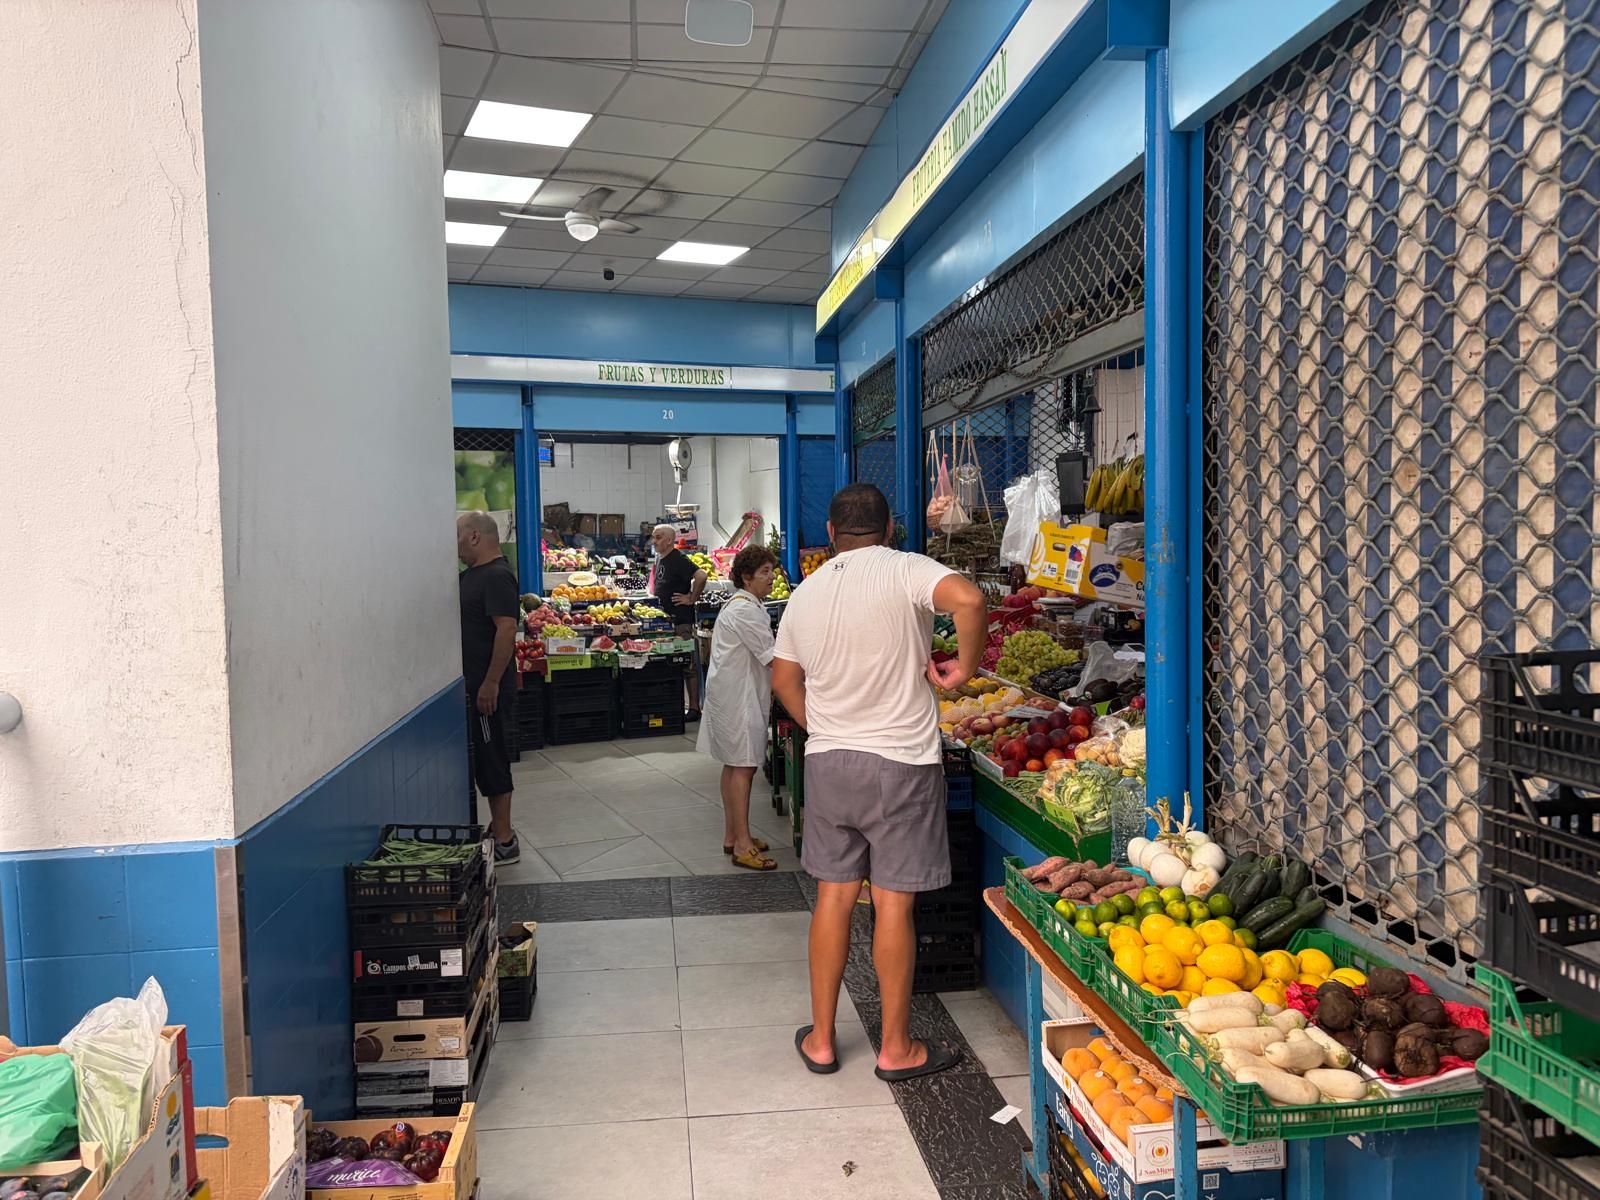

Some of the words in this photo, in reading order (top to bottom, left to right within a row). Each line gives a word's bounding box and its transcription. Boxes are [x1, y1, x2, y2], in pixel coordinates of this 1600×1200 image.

[942, 100, 971, 170] HAMIDO
[973, 48, 1007, 132] HASSAN
[598, 364, 644, 382] FRUTAS
[649, 367, 656, 383] Y
[661, 368, 724, 385] VERDURAS
[662, 409, 674, 420] 20
[383, 963, 406, 972] Campos
